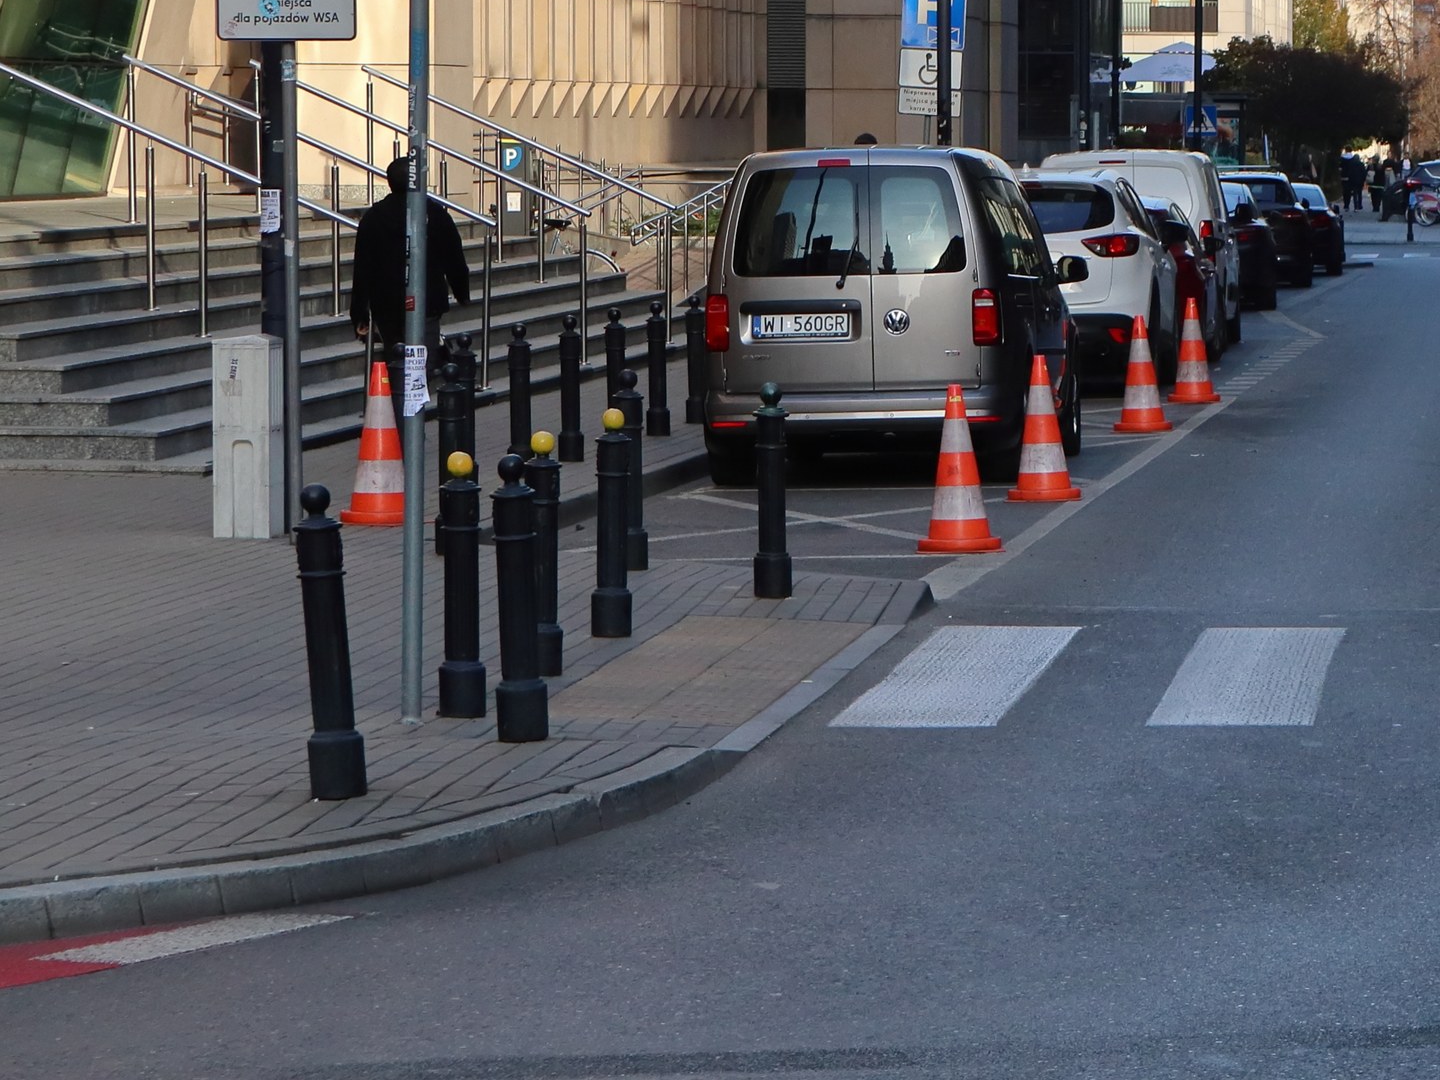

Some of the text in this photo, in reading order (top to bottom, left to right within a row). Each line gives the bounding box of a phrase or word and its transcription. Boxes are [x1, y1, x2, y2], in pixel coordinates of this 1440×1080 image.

[233, 12, 340, 26] dla pojazdów WSA
[505, 148, 517, 166] P
[408, 148, 417, 189] PUBLC
[793, 315, 845, 332] 560GR
